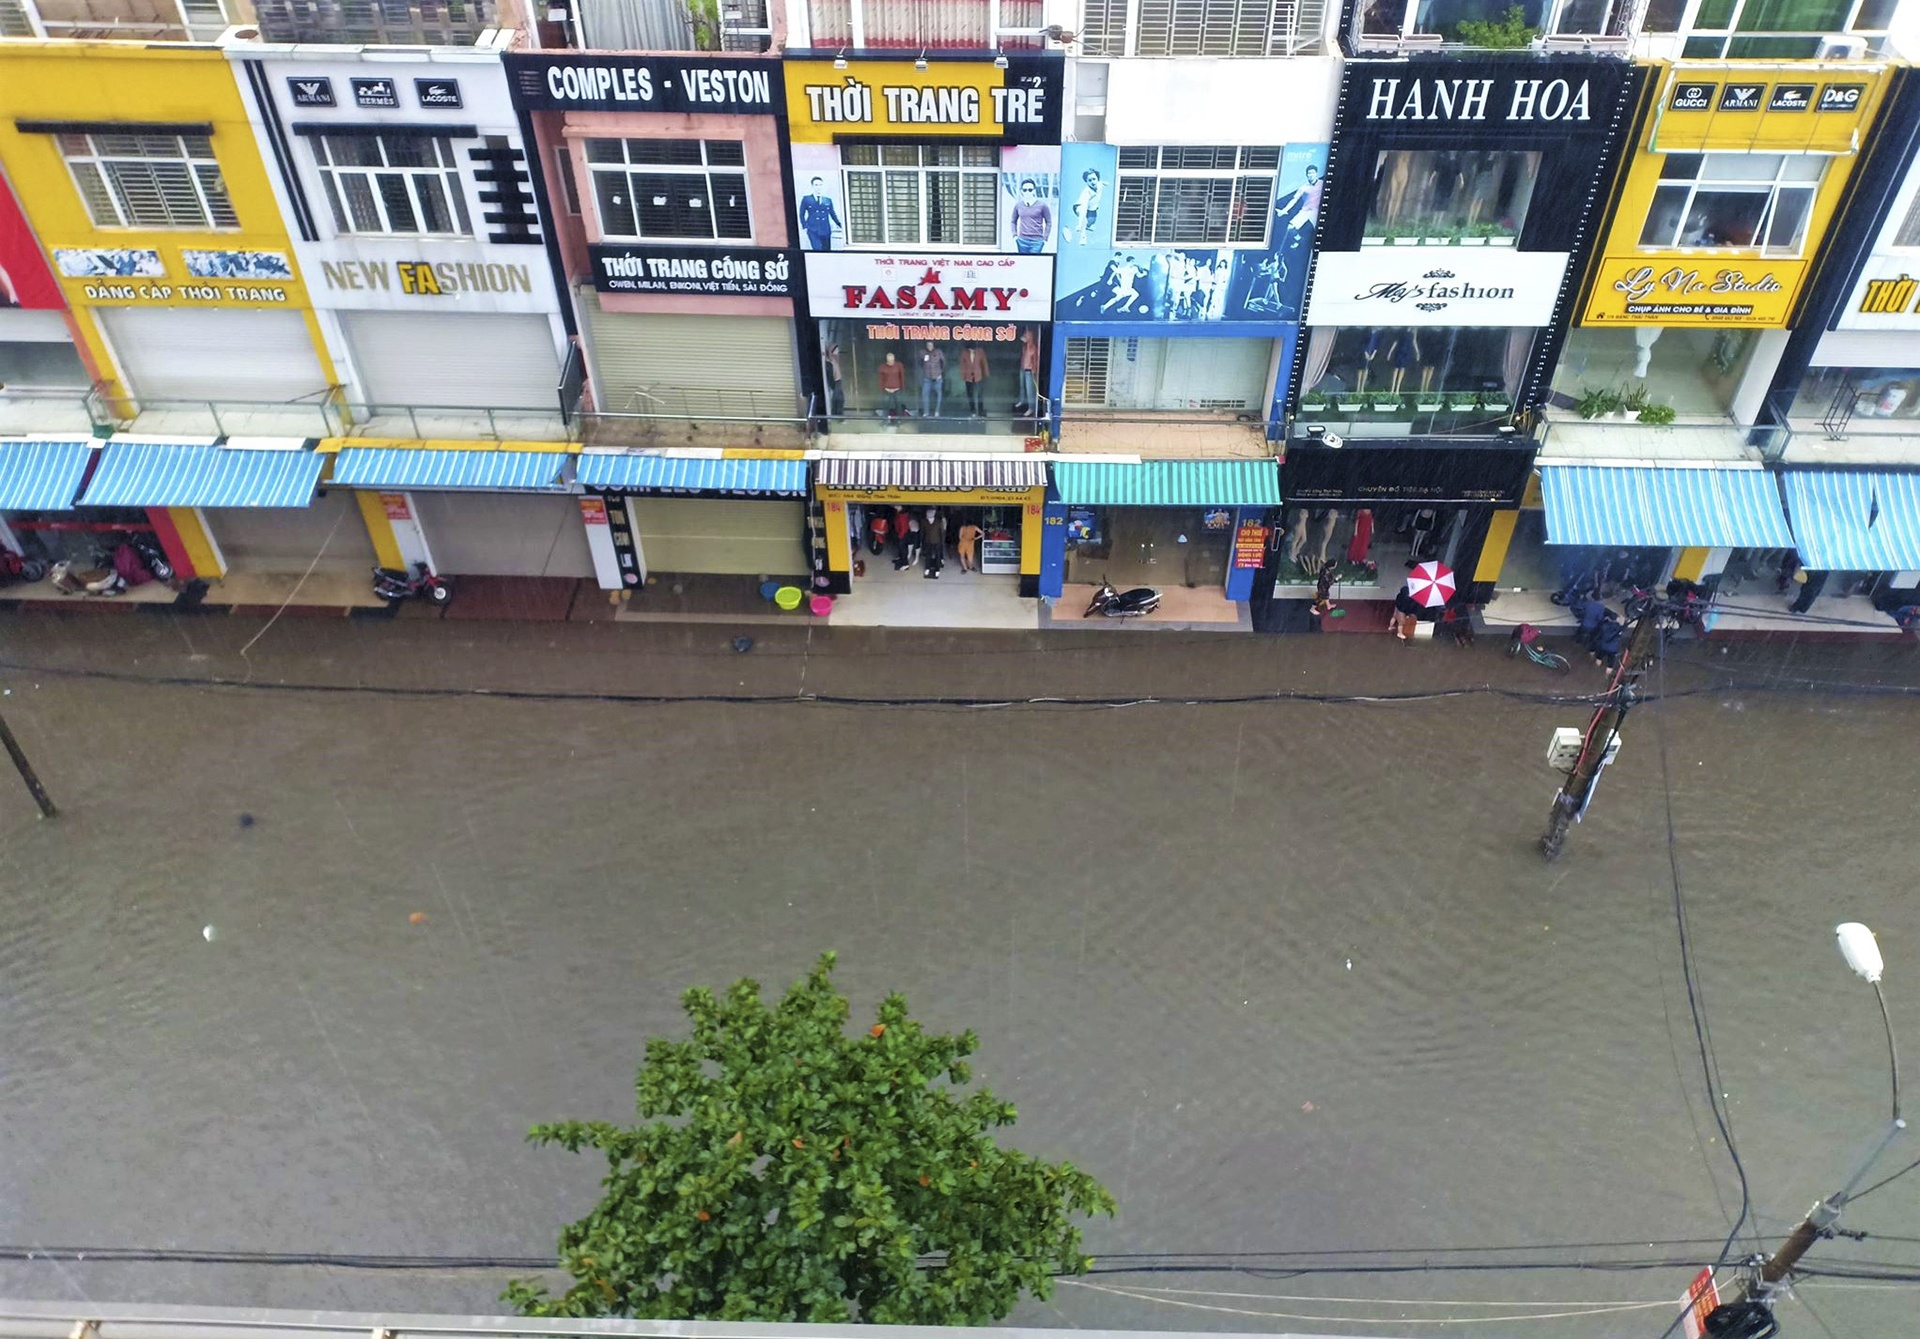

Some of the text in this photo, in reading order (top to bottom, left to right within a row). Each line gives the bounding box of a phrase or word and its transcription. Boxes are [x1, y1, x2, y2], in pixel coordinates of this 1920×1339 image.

[547, 66, 653, 101] COMPLES
[681, 69, 770, 103] VESTON
[421, 95, 458, 103] LACOSTE
[805, 76, 1044, 123] THỜI TRANG TRẺ
[1366, 78, 1591, 120] HANH HOA
[1675, 98, 1707, 107] GUCCI
[1723, 99, 1758, 107] ARMANI
[1823, 89, 1859, 102] D&G
[646, 258, 708, 279] TRANG
[898, 259, 928, 267] TRANG
[320, 260, 532, 294] NEW FASHION
[1711, 269, 1782, 292] Studio
[225, 286, 286, 301] TRANG
[842, 285, 1017, 311] FASAMY
[1426, 282, 1514, 298] fashion
[902, 325, 950, 341] TRANG
[1044, 516, 1063, 525] 182
